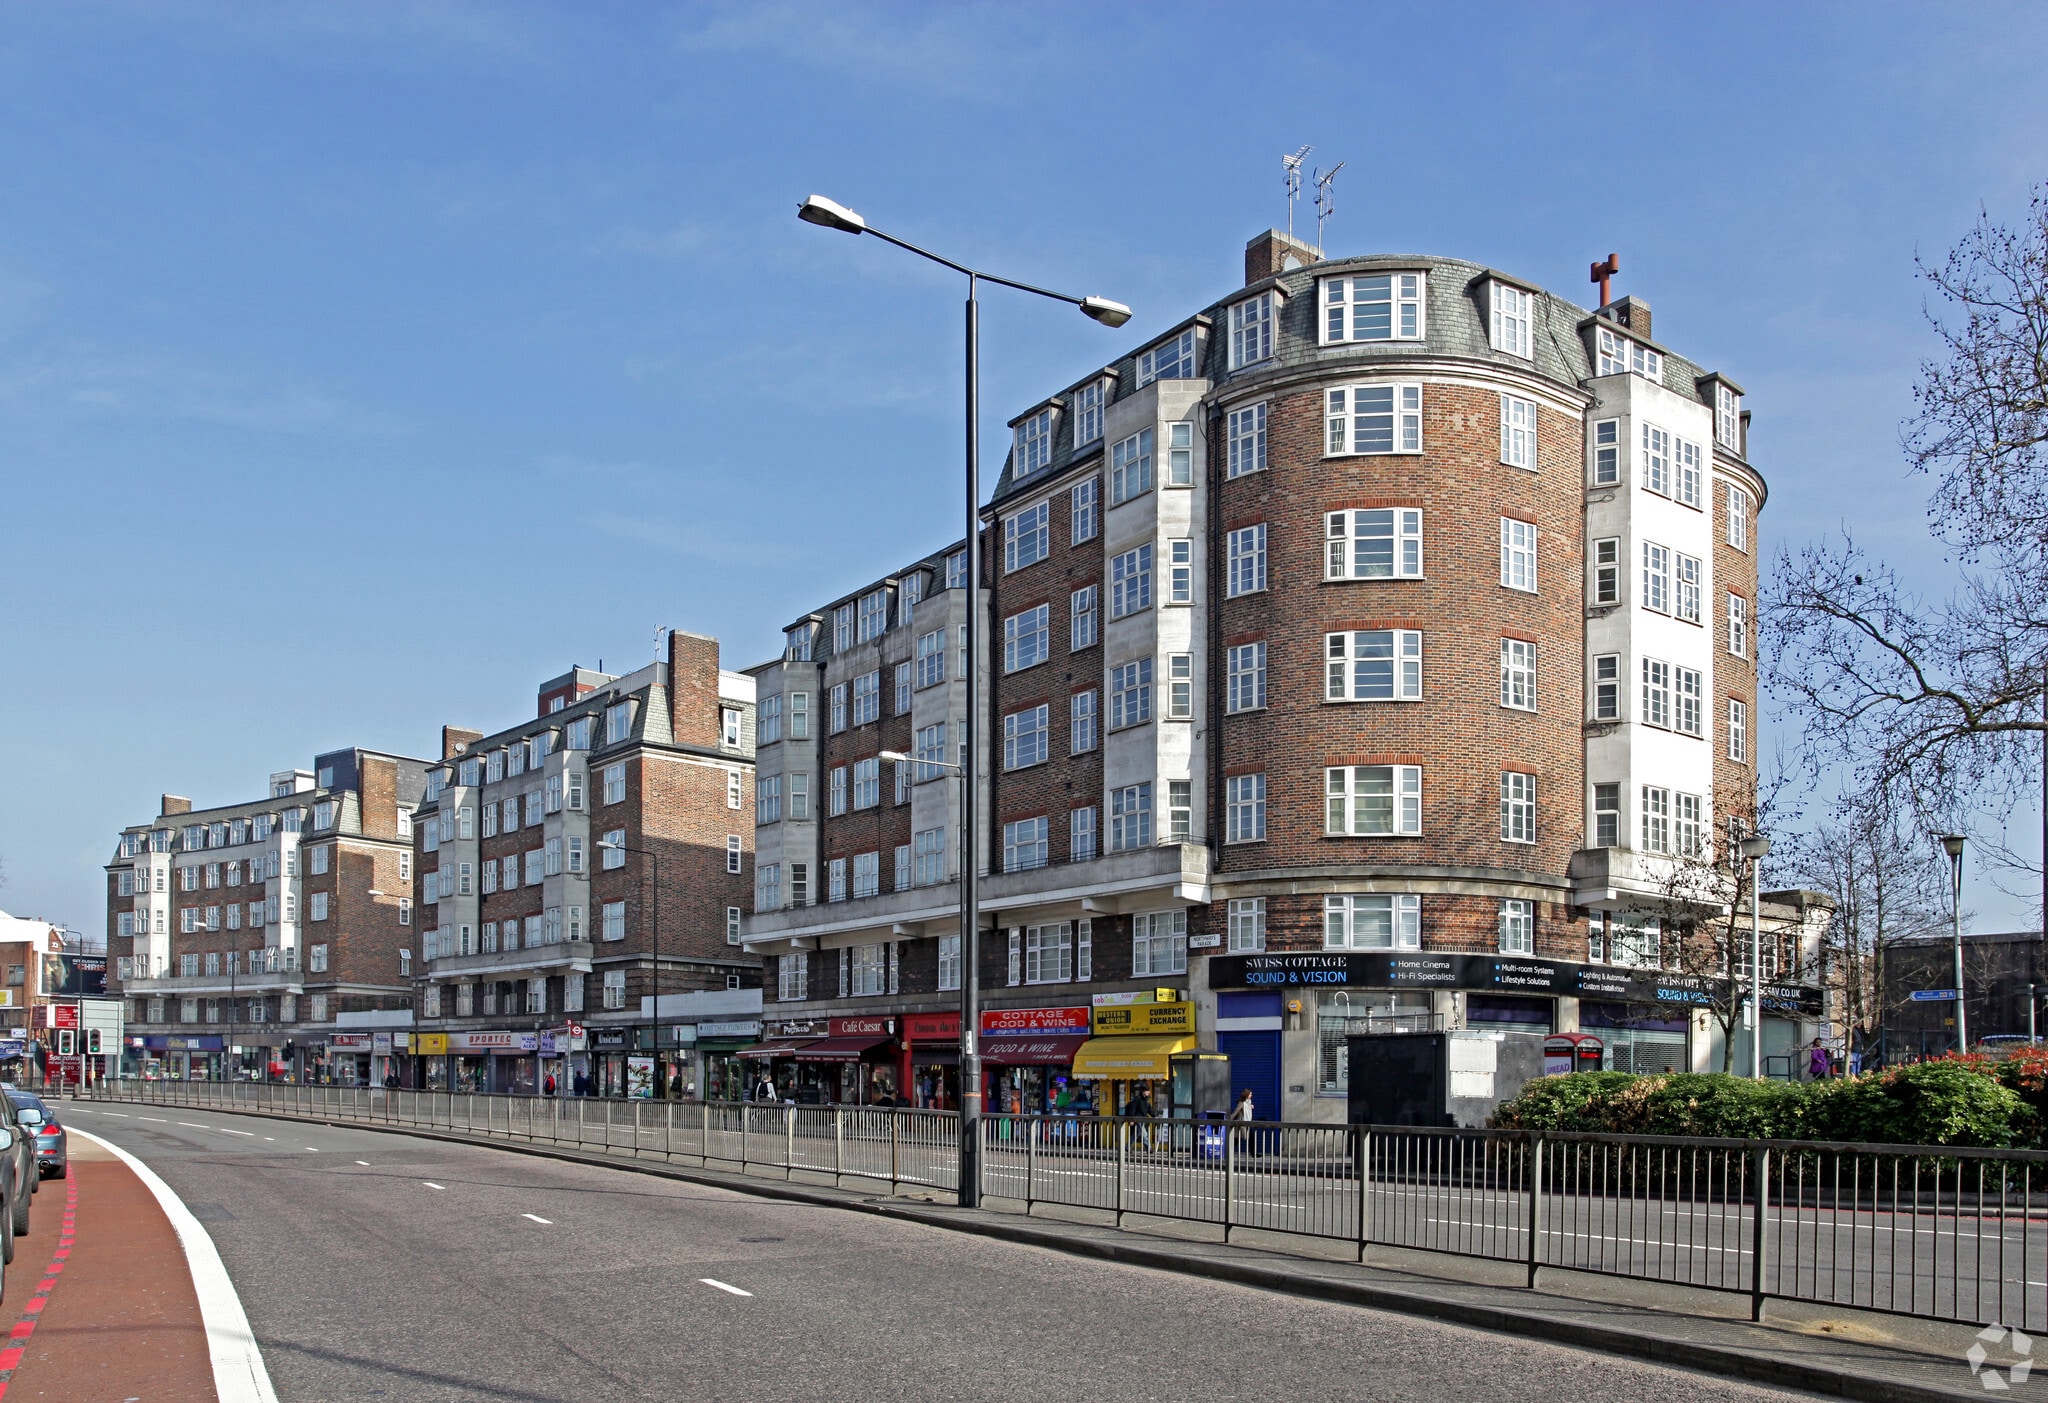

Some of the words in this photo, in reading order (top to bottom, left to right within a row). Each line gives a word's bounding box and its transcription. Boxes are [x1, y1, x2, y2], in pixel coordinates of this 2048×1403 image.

[1246, 957, 1282, 968] SWISS
[1285, 956, 1347, 968] COTTAGE
[1398, 960, 1420, 968] Home
[1423, 960, 1450, 969] Cinema
[1501, 963, 1533, 973] Multi-room
[1534, 965, 1555, 976] Systems
[1246, 972, 1286, 984] SOUND
[1289, 971, 1299, 983] &
[1302, 971, 1347, 983] VISION
[1398, 972, 1416, 980] Hi-Fi
[1418, 972, 1456, 981] Specialists
[1501, 975, 1526, 985] Lifestyle
[1527, 978, 1551, 986] Solutions
[1583, 982, 1600, 991] Custom
[1657, 988, 1681, 1001] SOUND
[1002, 1010, 1064, 1020] COTTAGE
[1149, 1008, 1187, 1016] CURRENCY
[991, 1020, 1026, 1028] FOOD
[1029, 1019, 1038, 1027] &
[1042, 1018, 1076, 1027] WINE
[1149, 1016, 1187, 1025] EXCHANGE
[842, 1021, 857, 1033] Café
[858, 1020, 881, 1032] Caesar
[988, 1044, 1017, 1053] FOOD
[1028, 1043, 1057, 1053] WINE
[1547, 1063, 1570, 1073] SPREAD
